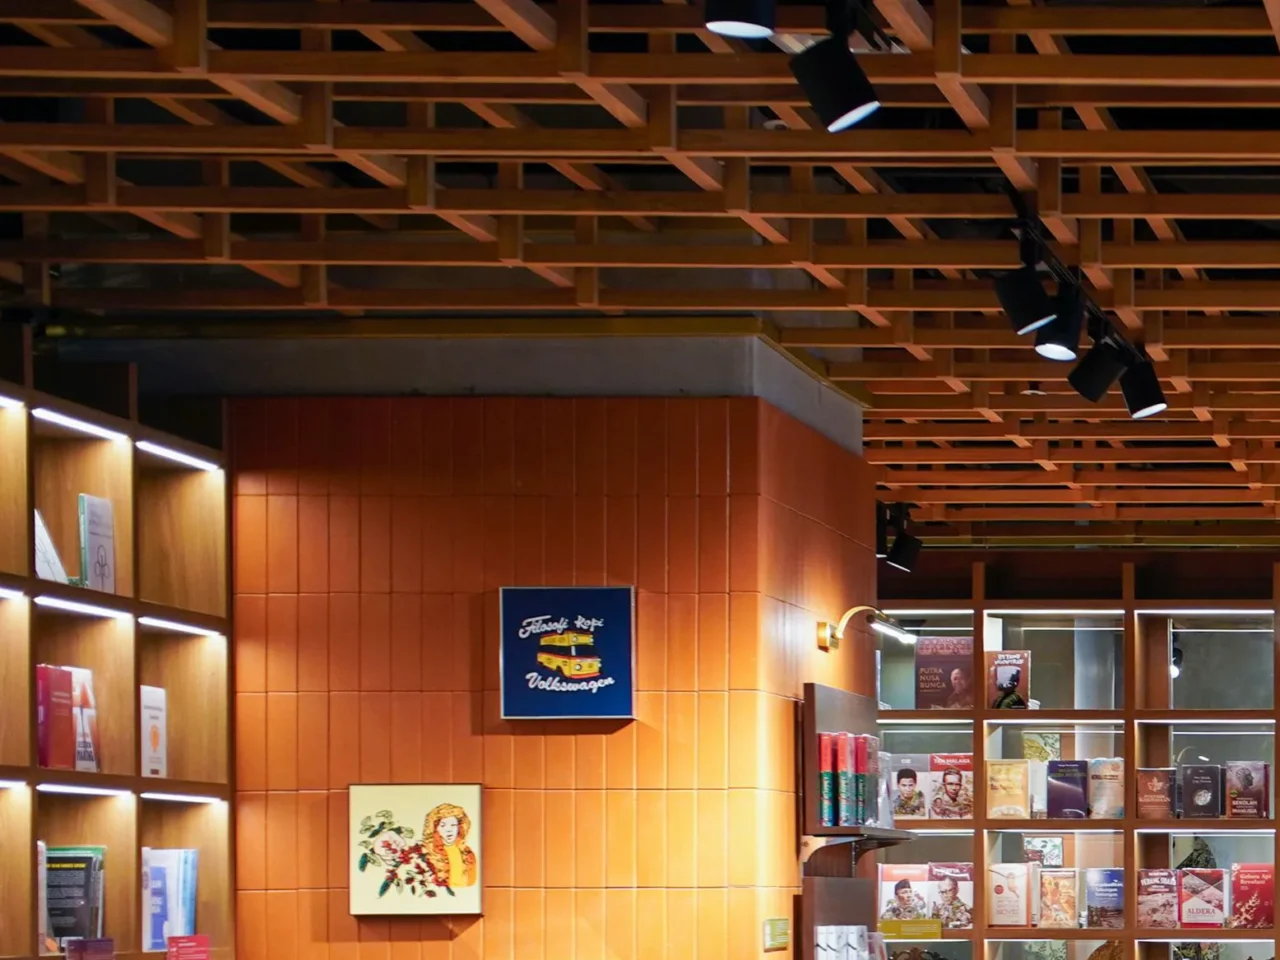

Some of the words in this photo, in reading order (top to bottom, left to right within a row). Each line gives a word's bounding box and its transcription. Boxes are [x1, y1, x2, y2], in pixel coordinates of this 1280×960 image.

[518, 615, 569, 639] Filosofi
[574, 615, 604, 632] Kopi
[919, 667, 943, 675] PUTRA
[525, 672, 615, 694] Volkswagen
